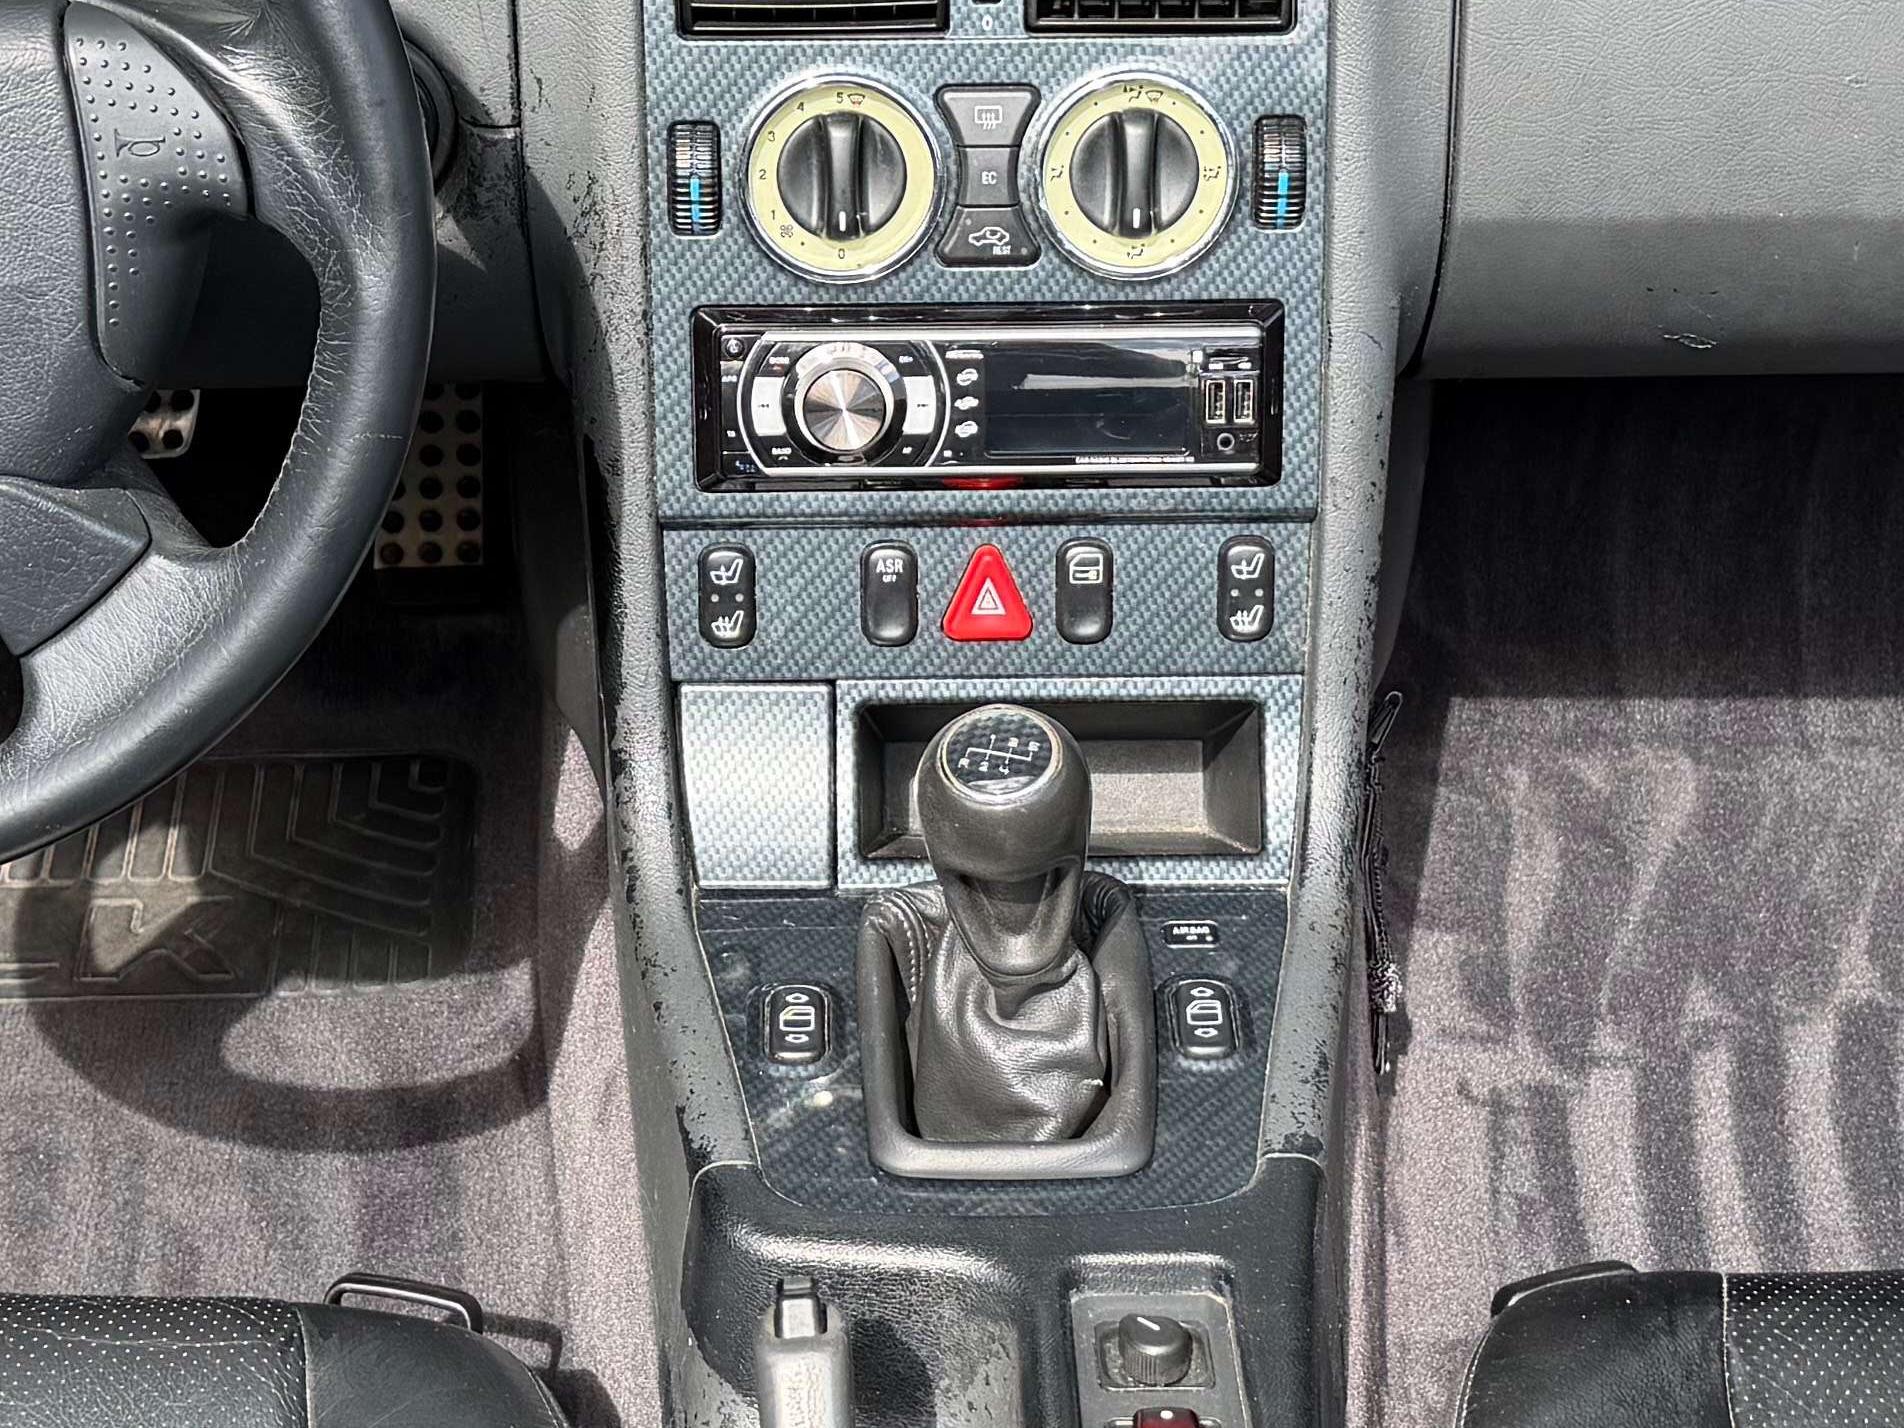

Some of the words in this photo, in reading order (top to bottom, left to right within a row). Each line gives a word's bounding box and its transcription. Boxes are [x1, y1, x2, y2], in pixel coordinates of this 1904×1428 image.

[836, 92, 844, 104] 5
[796, 102, 805, 112] 4
[767, 130, 776, 142] 3
[759, 169, 767, 180] 2
[981, 172, 997, 185] EC
[838, 248, 845, 260] 0
[876, 558, 904, 573] ASR
